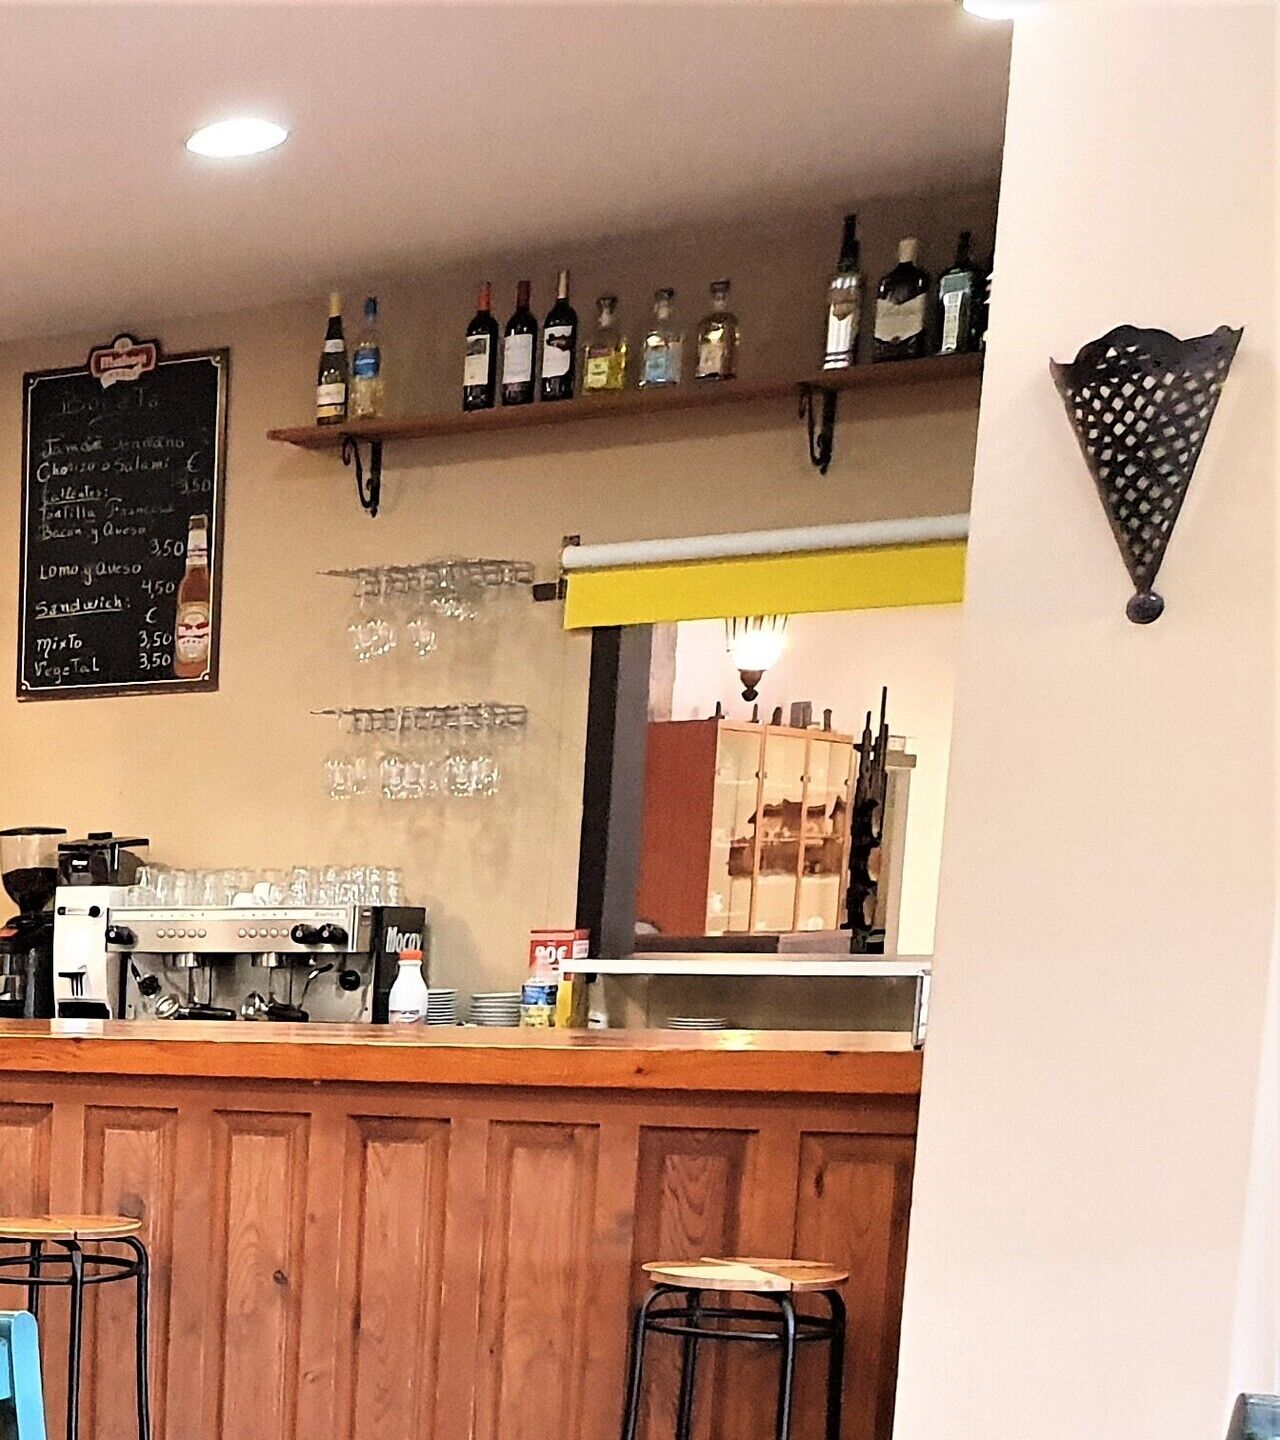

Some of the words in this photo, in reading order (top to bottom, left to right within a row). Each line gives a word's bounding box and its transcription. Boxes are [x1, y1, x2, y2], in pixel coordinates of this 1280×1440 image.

[91, 526, 99, 544] y
[149, 538, 184, 557] 3,50
[83, 567, 93, 586] y
[95, 561, 142, 576] Queso
[140, 579, 176, 599] 4,50
[139, 630, 173, 650] 3,50
[139, 652, 172, 670] 3,50
